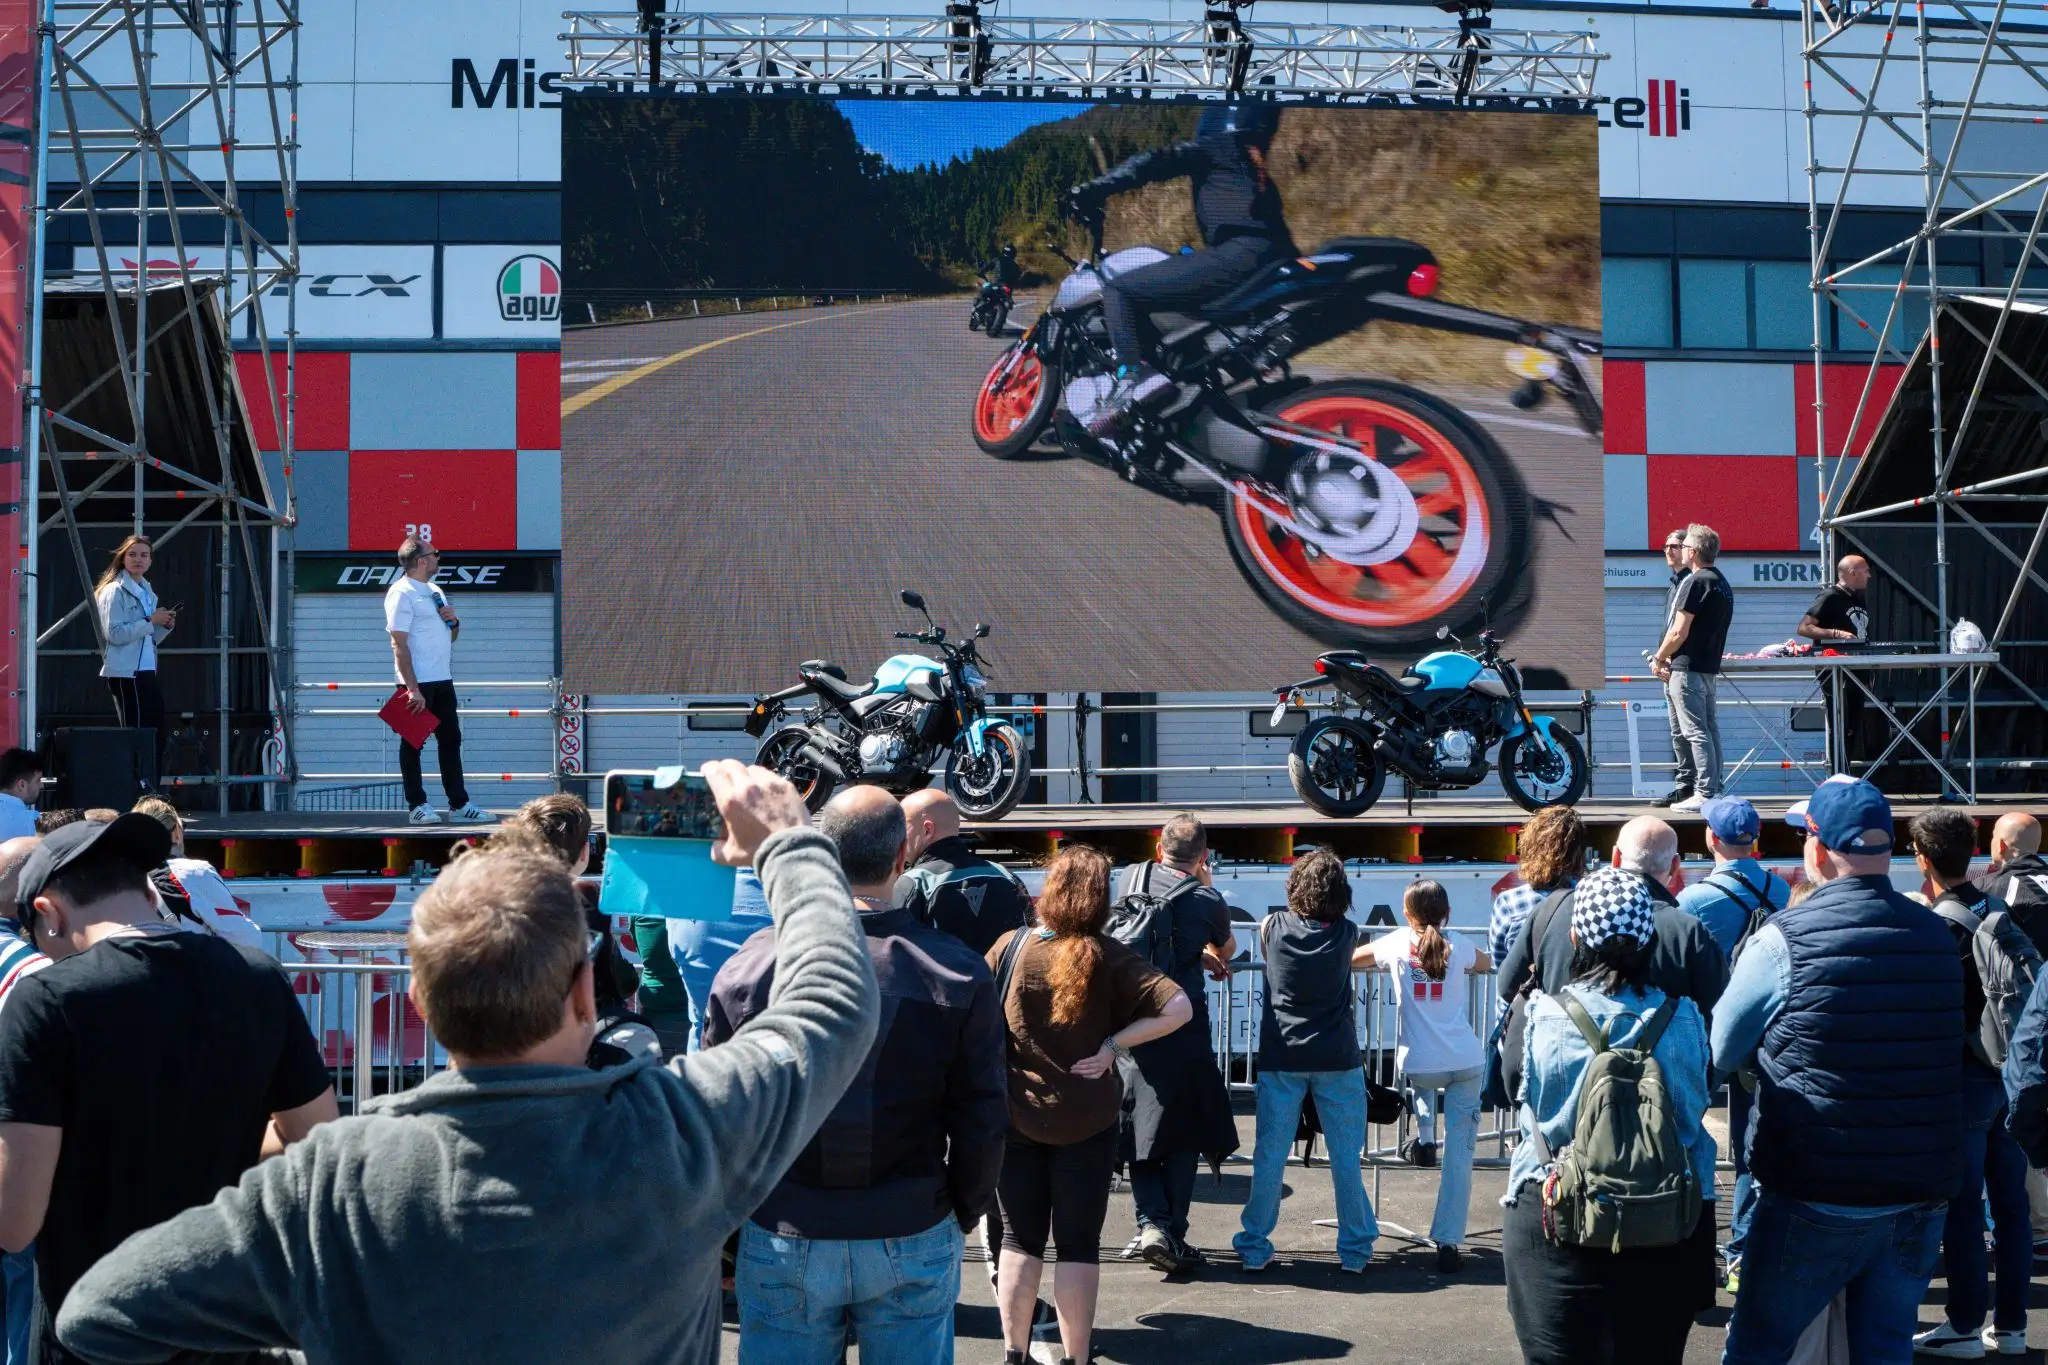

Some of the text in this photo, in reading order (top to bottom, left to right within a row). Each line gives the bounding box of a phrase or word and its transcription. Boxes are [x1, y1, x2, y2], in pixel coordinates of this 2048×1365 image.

[451, 58, 562, 109] Mis
[268, 275, 421, 297] TCX
[506, 296, 556, 321] agv
[337, 566, 505, 585] DAIESE
